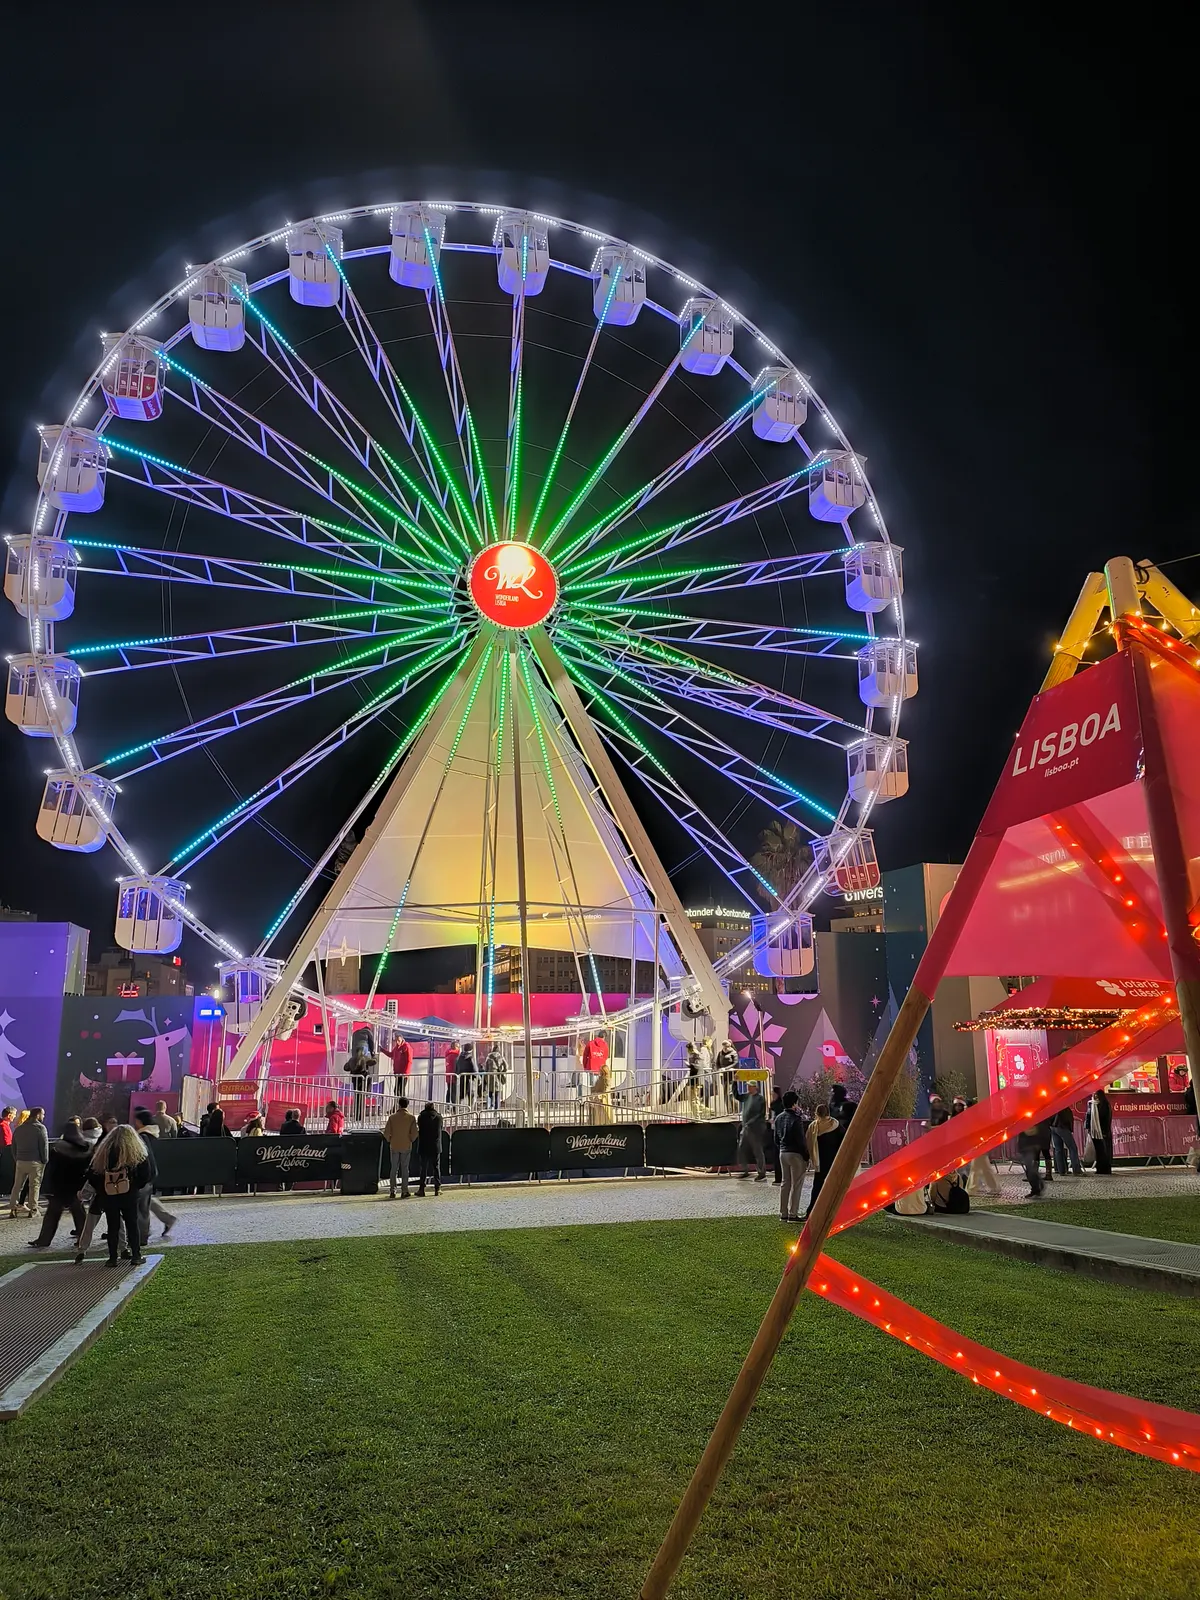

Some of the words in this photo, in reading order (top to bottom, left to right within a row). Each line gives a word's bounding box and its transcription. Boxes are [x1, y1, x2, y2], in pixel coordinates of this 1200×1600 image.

[1012, 702, 1121, 777] LISBOA
[1044, 757, 1080, 778] lisboa.pt
[722, 908, 751, 919] Santander
[1119, 980, 1160, 989] lotaria
[1129, 988, 1169, 998] clássic
[221, 1084, 255, 1092] ENTRADA
[1119, 1103, 1138, 1112] mais
[1138, 1102, 1166, 1113] mágico
[1119, 1124, 1140, 1134] sorte
[566, 1133, 628, 1149] Wonderland
[256, 1144, 328, 1160] Wonderland
[584, 1145, 613, 1160] Lisboa
[275, 1156, 310, 1172] Lisboa
